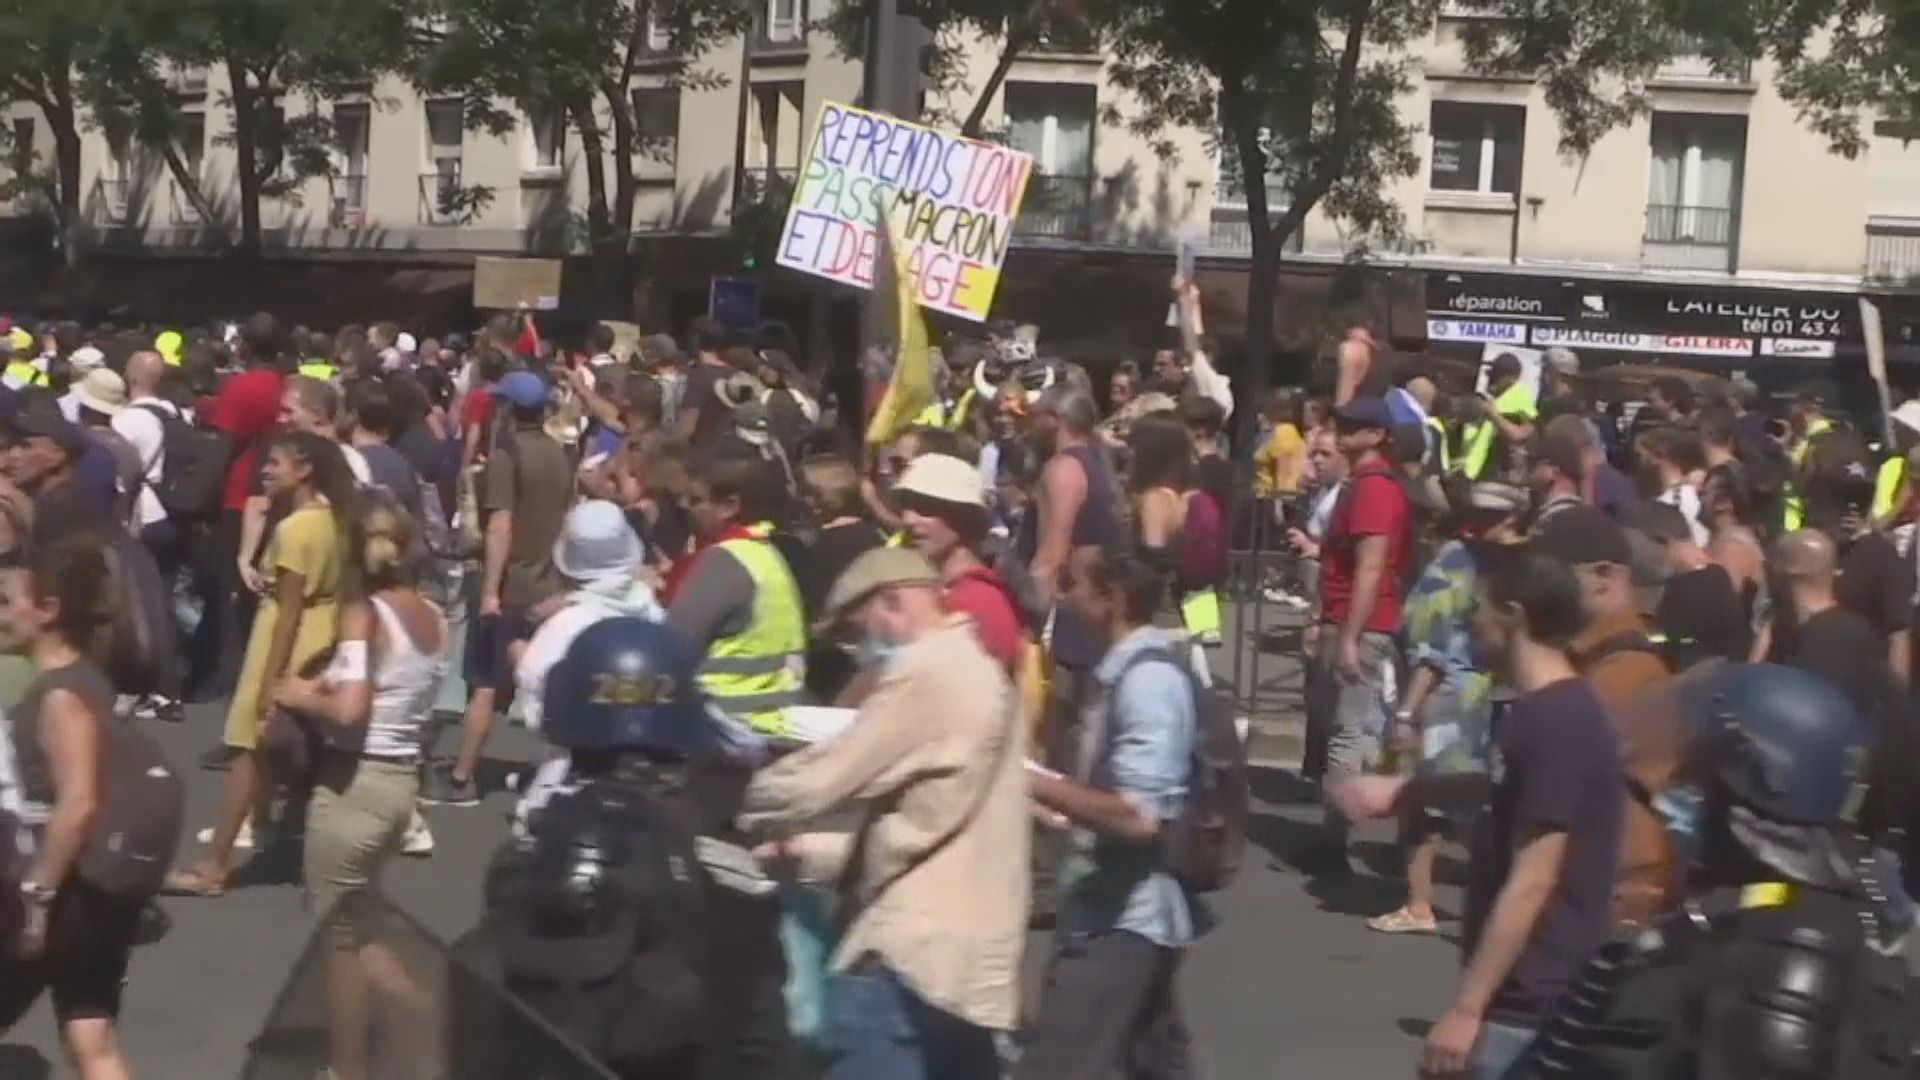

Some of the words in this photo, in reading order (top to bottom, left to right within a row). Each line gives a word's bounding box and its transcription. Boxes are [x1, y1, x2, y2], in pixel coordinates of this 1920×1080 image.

[813, 105, 968, 200] REPRENDS
[960, 140, 1028, 217] TON
[796, 158, 896, 227] PASS
[891, 187, 1014, 265] MACRON
[784, 210, 846, 268] ET
[822, 222, 983, 310] DEAGE
[1457, 322, 1517, 340] YAMAHA
[1554, 327, 1641, 347] PIAGGIO
[1771, 319, 1793, 336] 01
[1800, 320, 1825, 337] 43
[1664, 334, 1750, 351] GILERA
